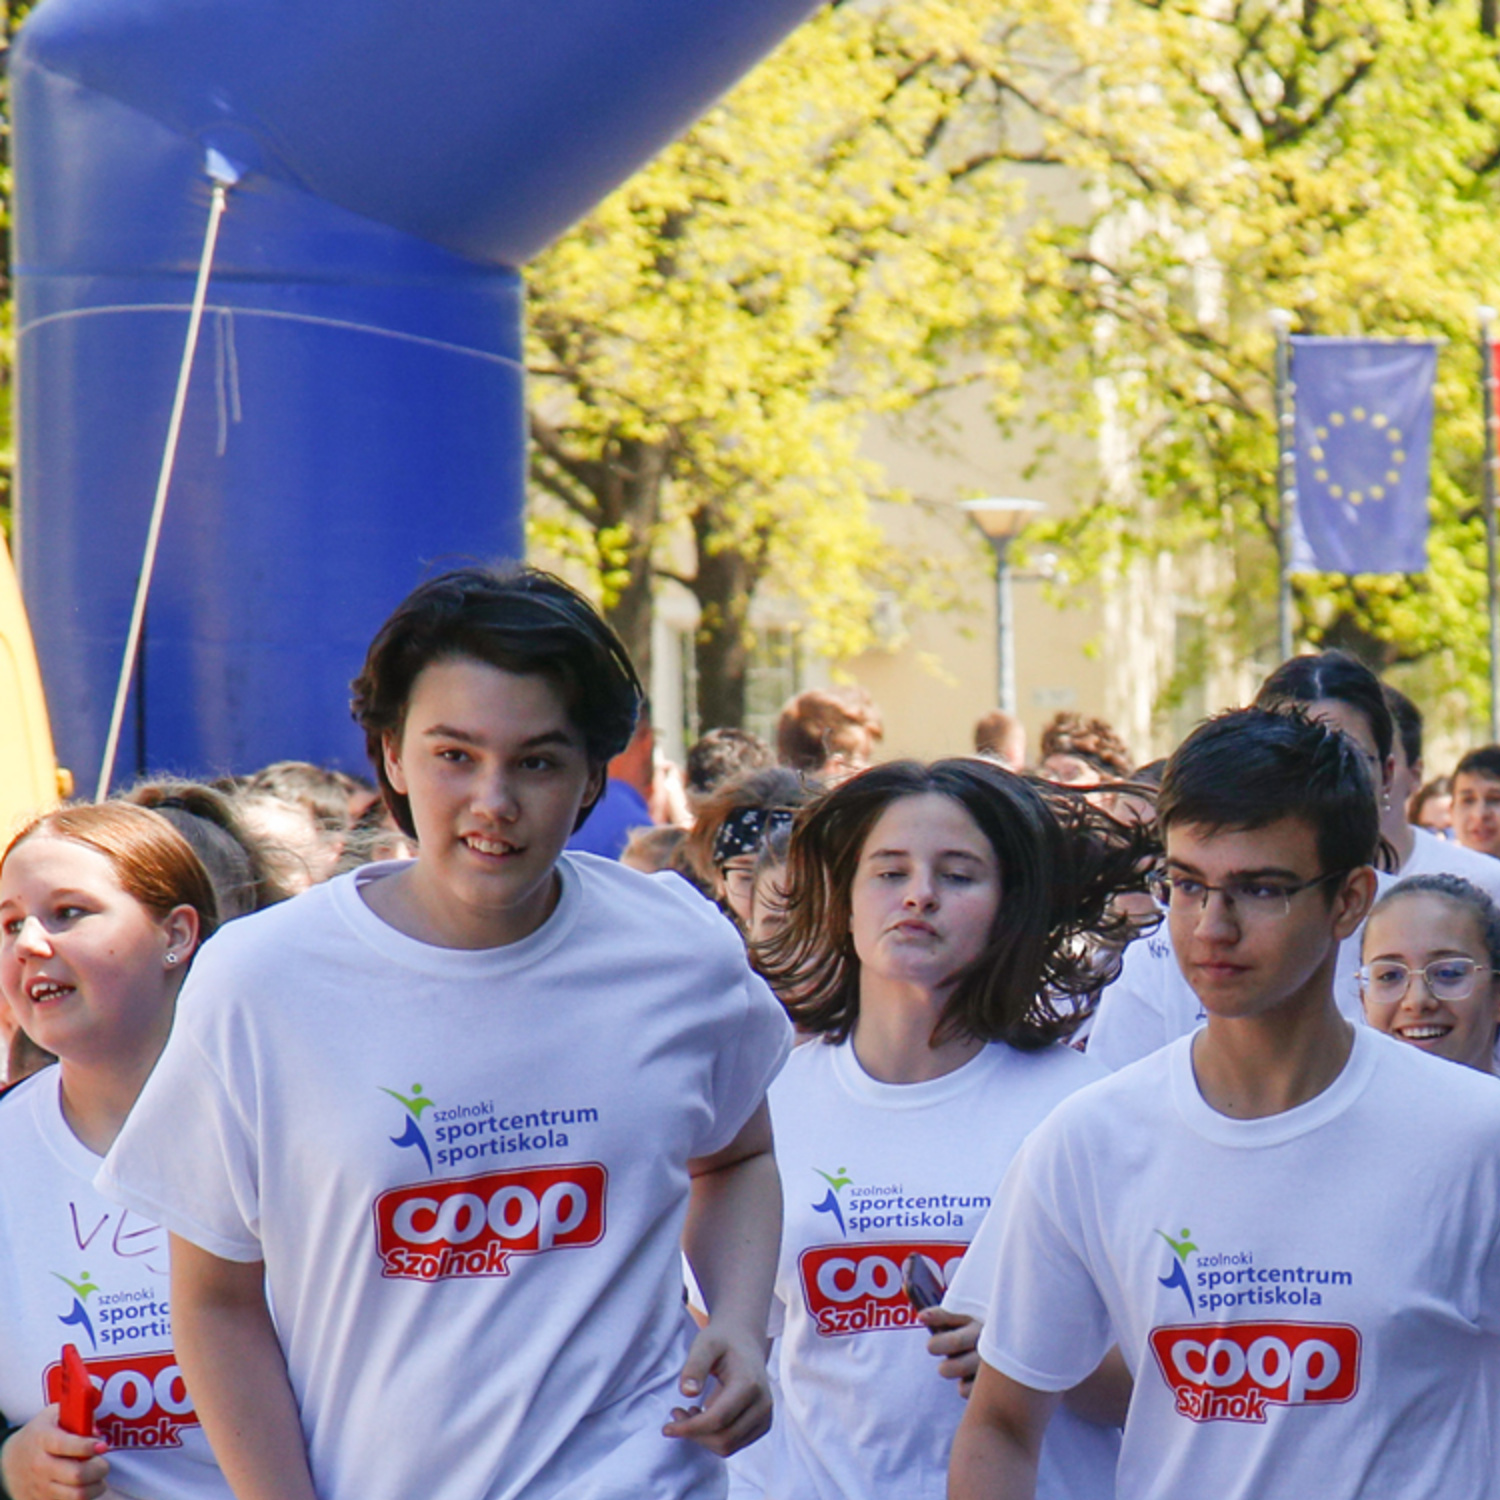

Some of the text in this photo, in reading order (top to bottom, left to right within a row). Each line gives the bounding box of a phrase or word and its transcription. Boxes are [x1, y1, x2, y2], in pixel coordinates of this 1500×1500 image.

[433, 1100, 494, 1122] szolnoki
[435, 1107, 599, 1144] sportcentrum
[437, 1130, 569, 1167] sportiskola
[851, 1184, 903, 1198] szolnoki
[392, 1181, 588, 1250] coop
[849, 1194, 992, 1214] sportcentrum
[848, 1211, 964, 1233] sportiskola
[385, 1242, 510, 1279] Szolnok
[1197, 1251, 1253, 1268] szolnoki
[1197, 1266, 1353, 1290] sportcentrum
[98, 1288, 155, 1305] szolnoki
[1198, 1286, 1322, 1312] sportiskola
[99, 1301, 170, 1325] sportc
[1171, 1336, 1341, 1403] coop
